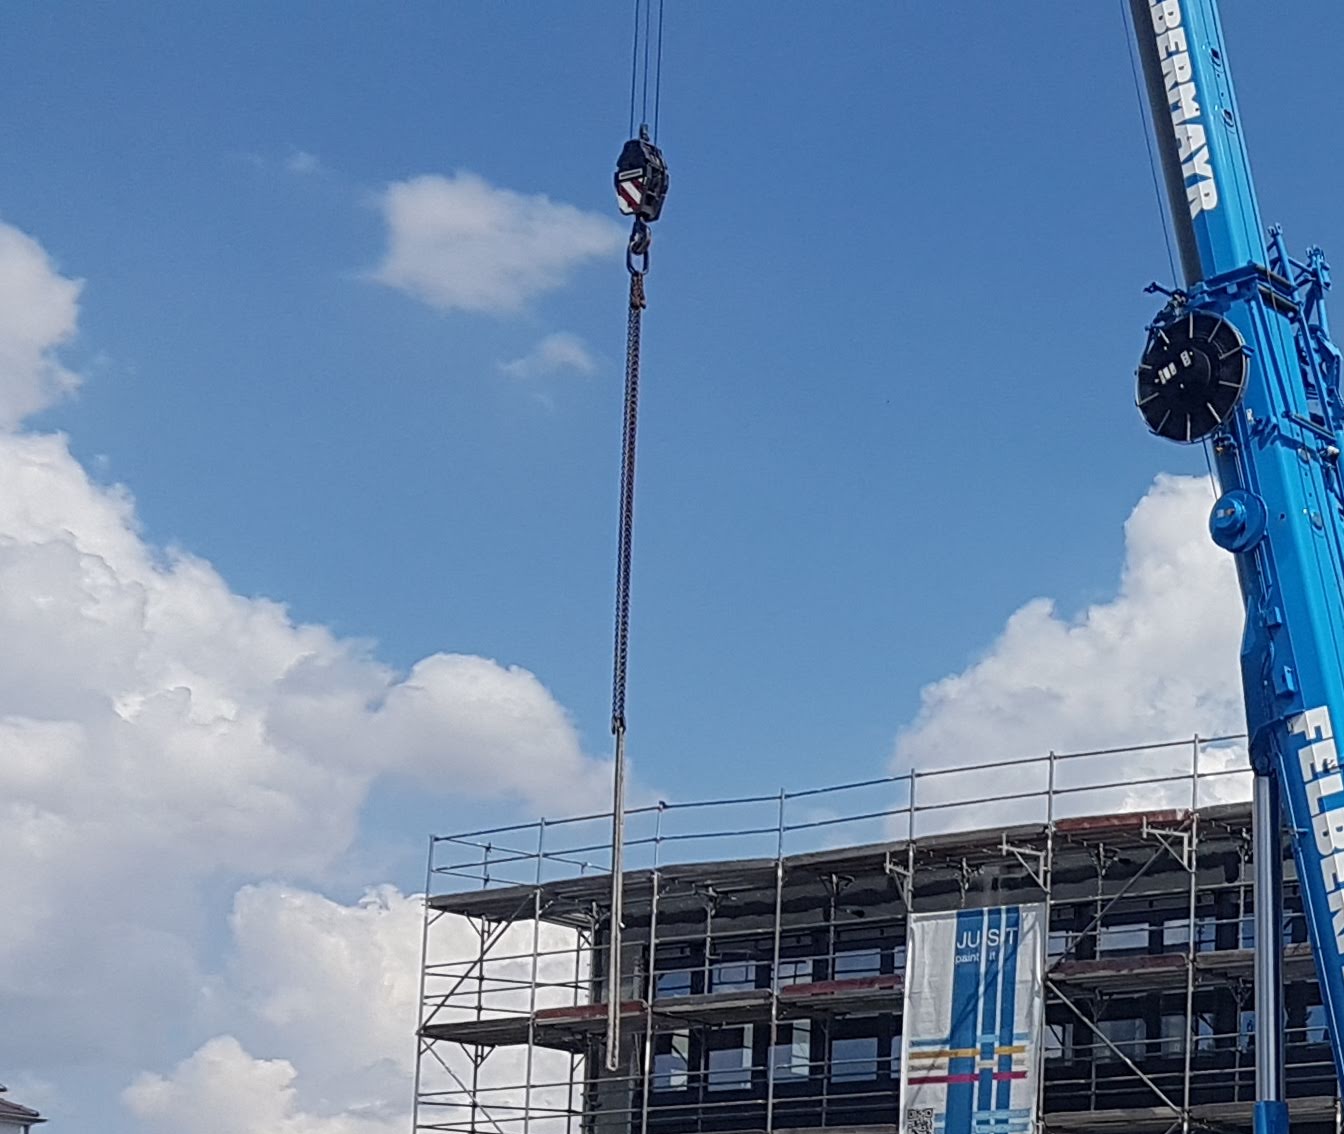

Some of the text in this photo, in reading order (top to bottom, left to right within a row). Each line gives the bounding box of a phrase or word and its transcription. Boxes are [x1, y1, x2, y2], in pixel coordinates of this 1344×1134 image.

[1149, 0, 1218, 220] BERMAYR
[957, 927, 1018, 949] JUST
[955, 953, 980, 964] paint
